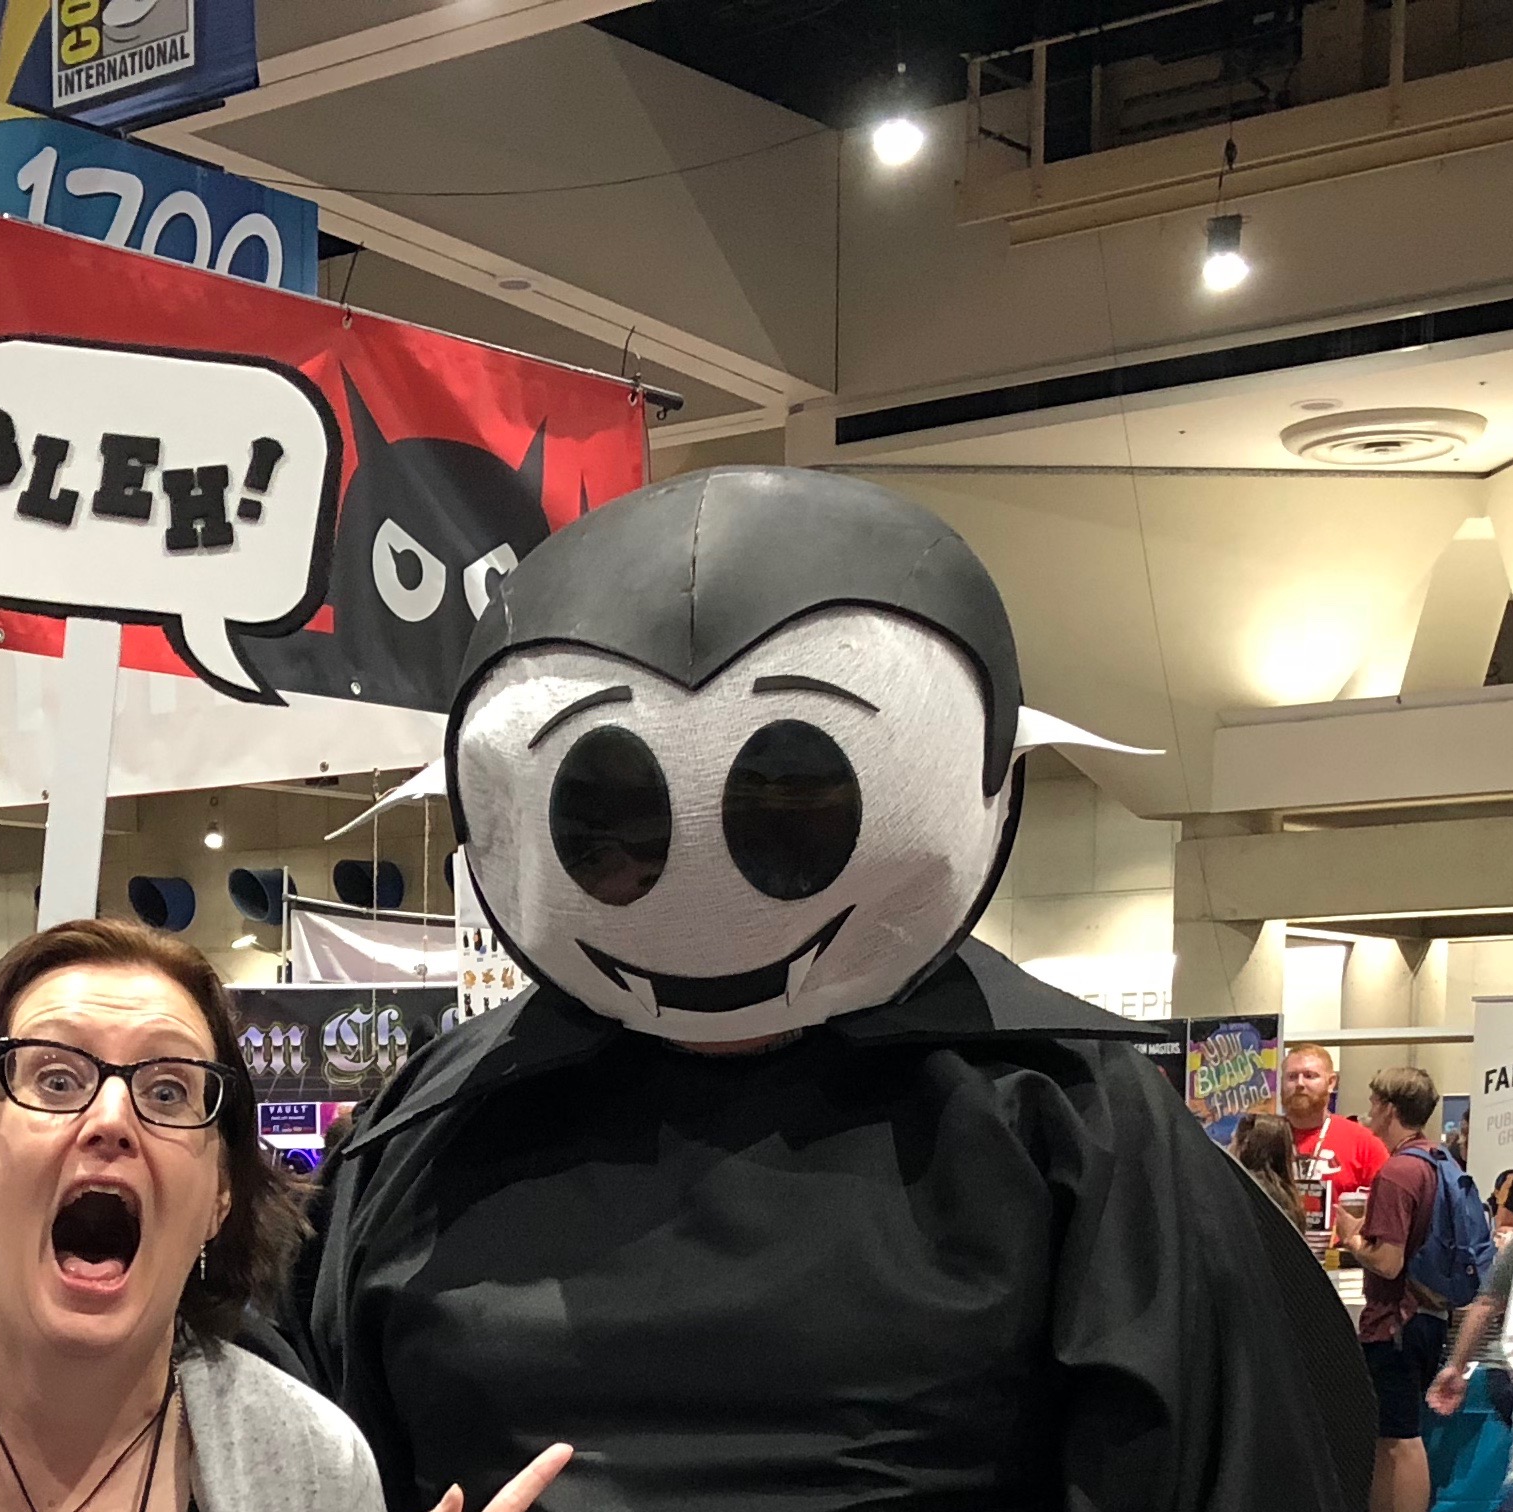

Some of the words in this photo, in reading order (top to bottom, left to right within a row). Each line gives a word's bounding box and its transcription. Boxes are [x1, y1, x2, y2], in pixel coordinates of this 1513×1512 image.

[58, 35, 190, 98] INTERNATIONAL
[17, 146, 284, 293] 1700
[1484, 1065, 1513, 1095] FA
[269, 1105, 308, 1114] VAULT
